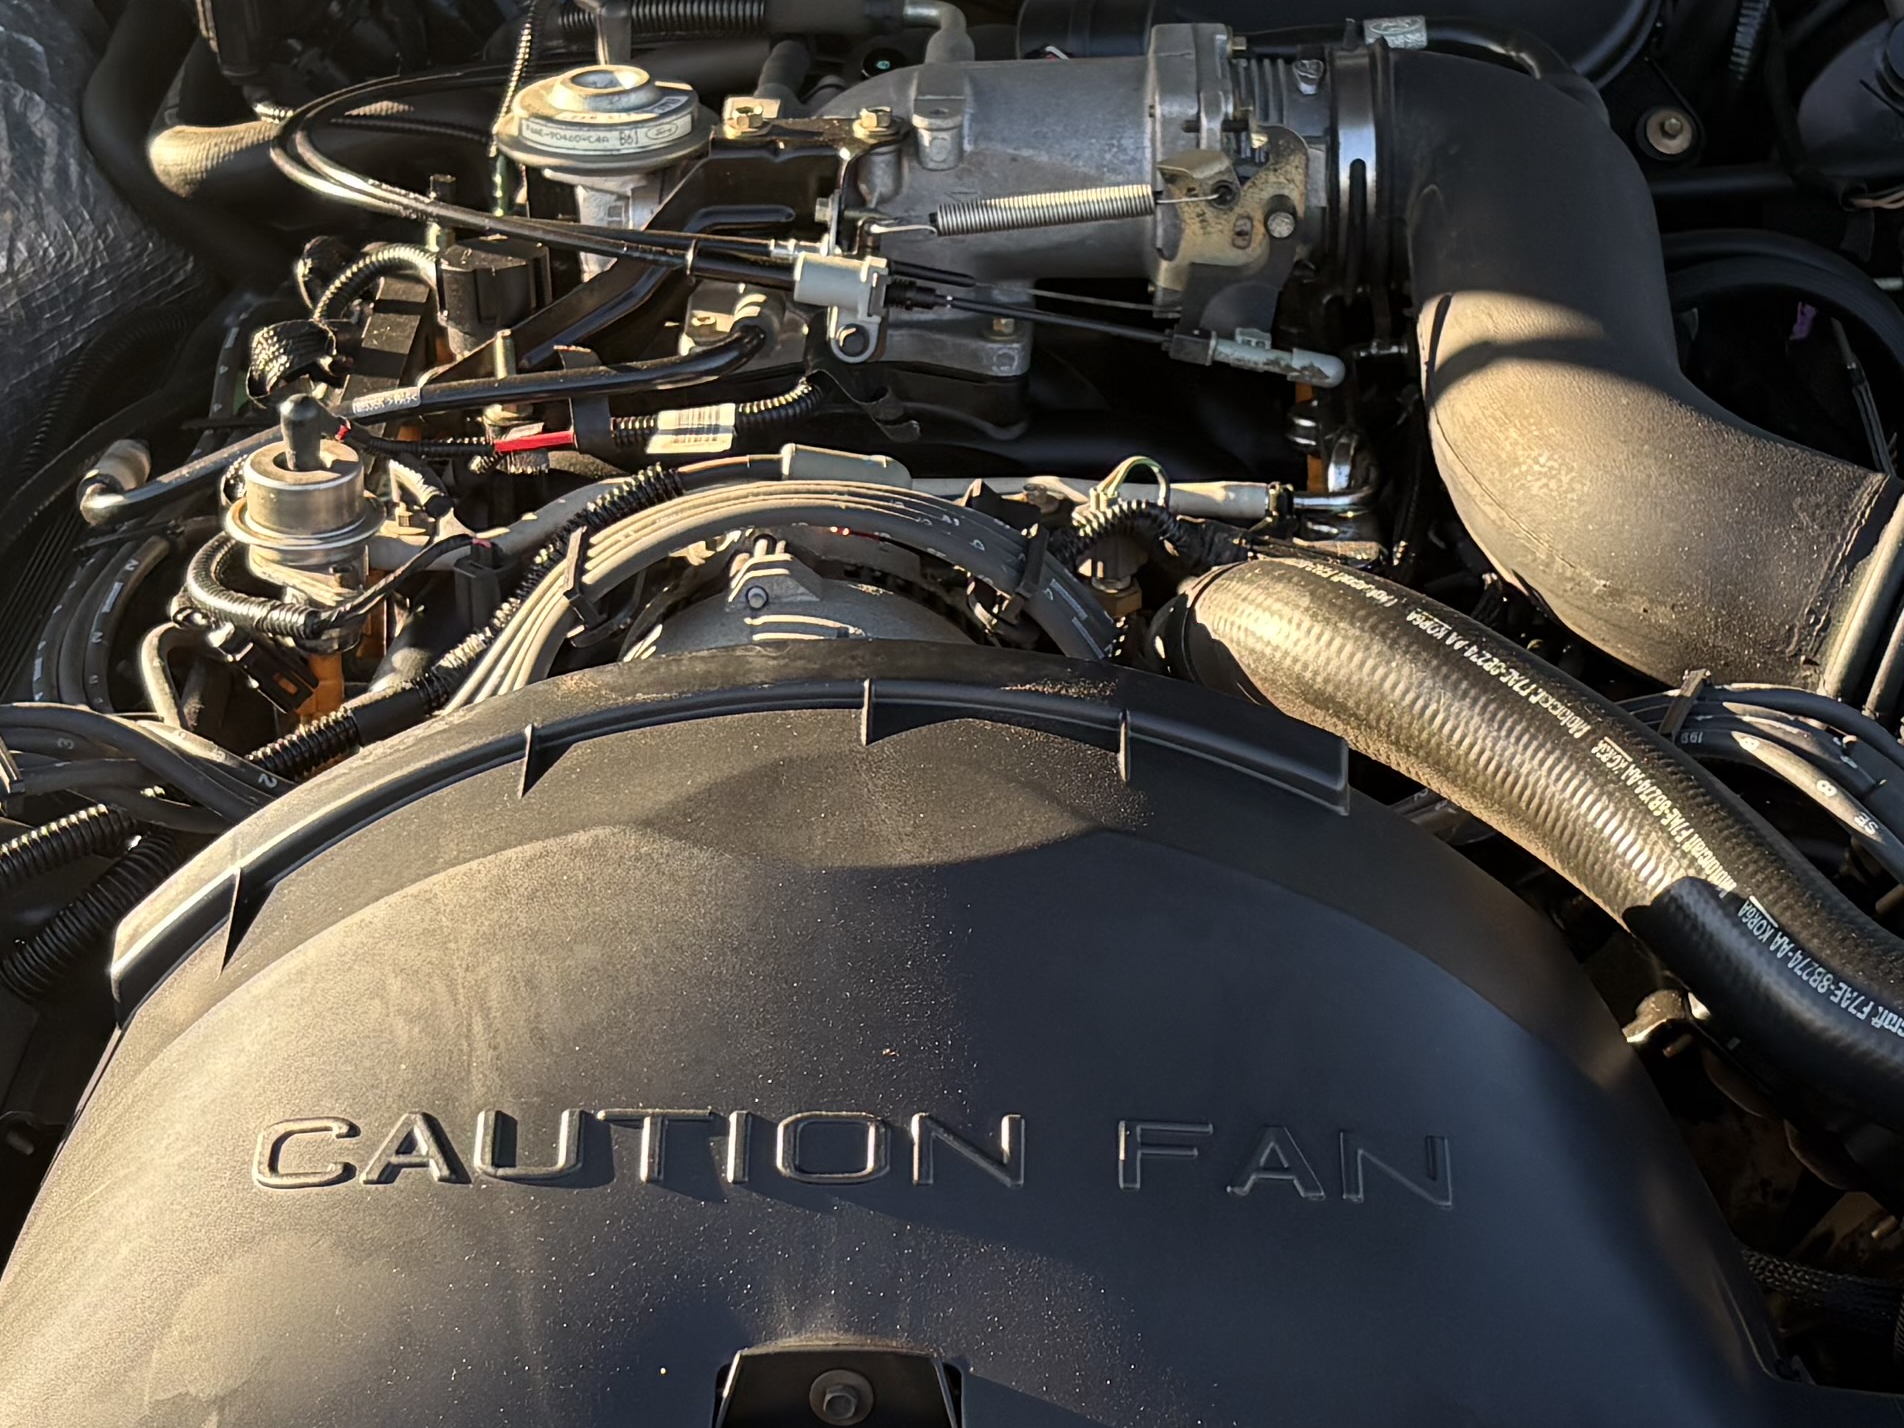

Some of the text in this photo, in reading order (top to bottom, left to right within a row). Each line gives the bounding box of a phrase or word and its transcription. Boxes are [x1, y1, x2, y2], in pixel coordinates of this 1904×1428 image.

[1737, 899, 1775, 944] KOR6A
[1769, 931, 1875, 1021] F7AE-8B274-AA
[252, 1106, 1453, 1211] CAUTION FAN
